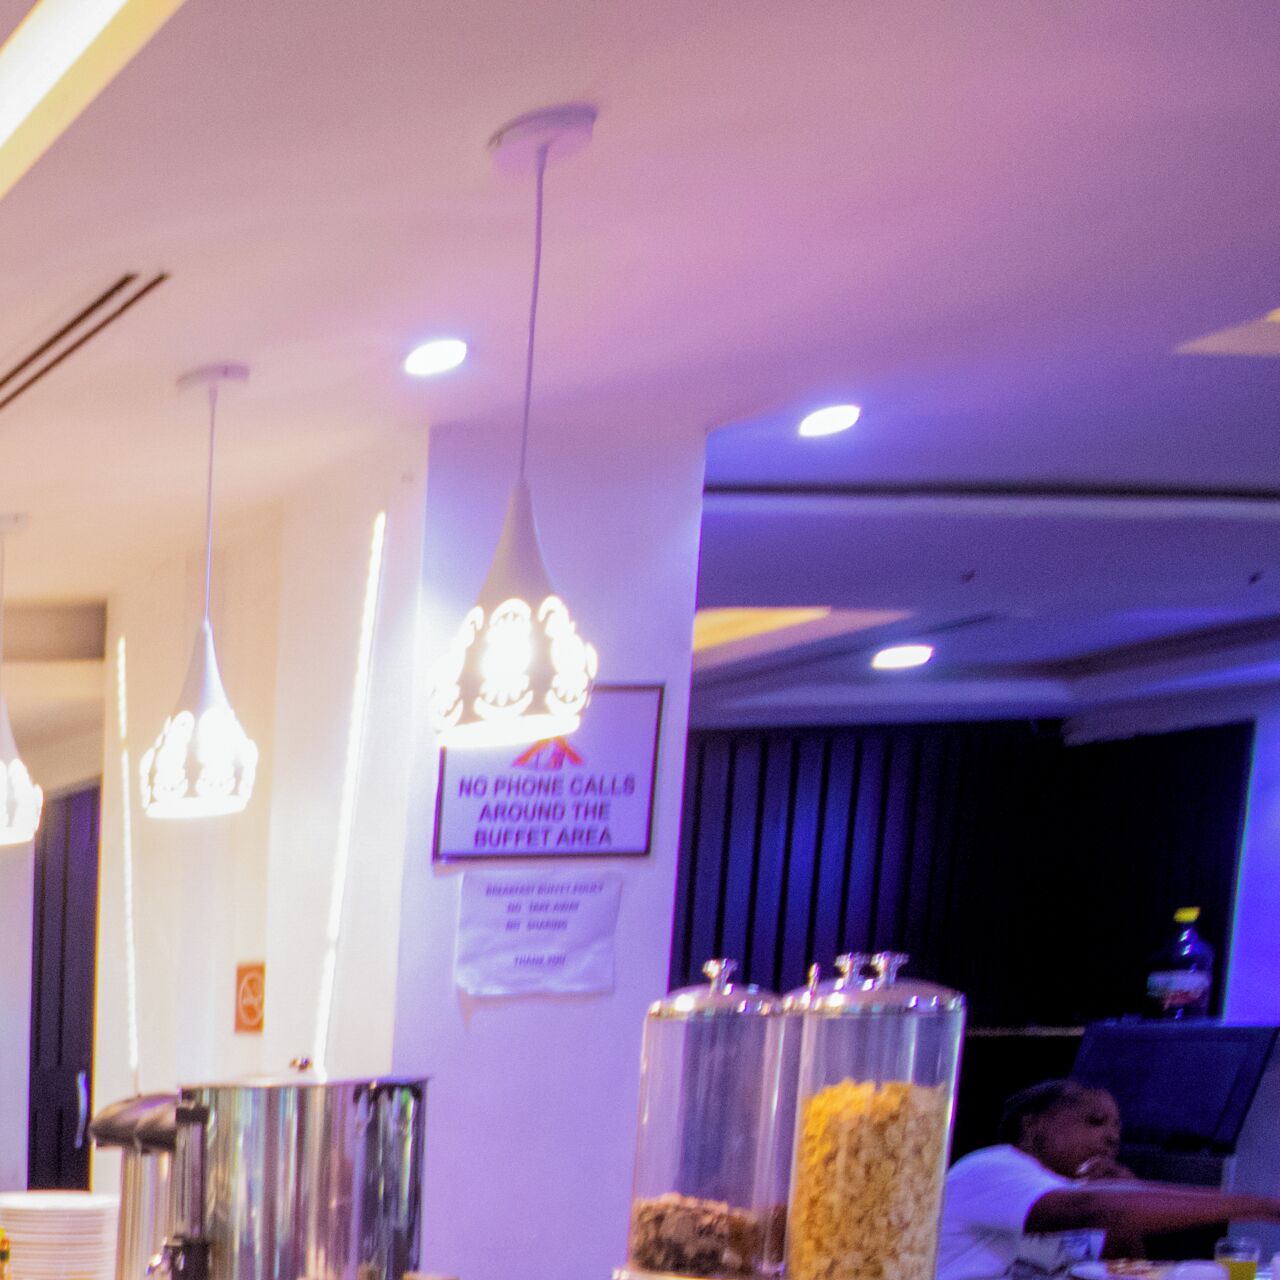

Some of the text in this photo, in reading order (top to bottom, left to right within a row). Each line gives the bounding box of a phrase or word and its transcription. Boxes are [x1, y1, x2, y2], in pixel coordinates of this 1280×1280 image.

[459, 772, 636, 798] NO PHONE CALLS
[479, 801, 610, 823] AROUND THE
[474, 826, 613, 848] BUFFET AREA
[485, 880, 605, 896] BREAKFAST BUFFET POLICY
[506, 901, 522, 913] NO
[505, 919, 568, 931] NO SHARING
[514, 953, 566, 967] THANK YOU
